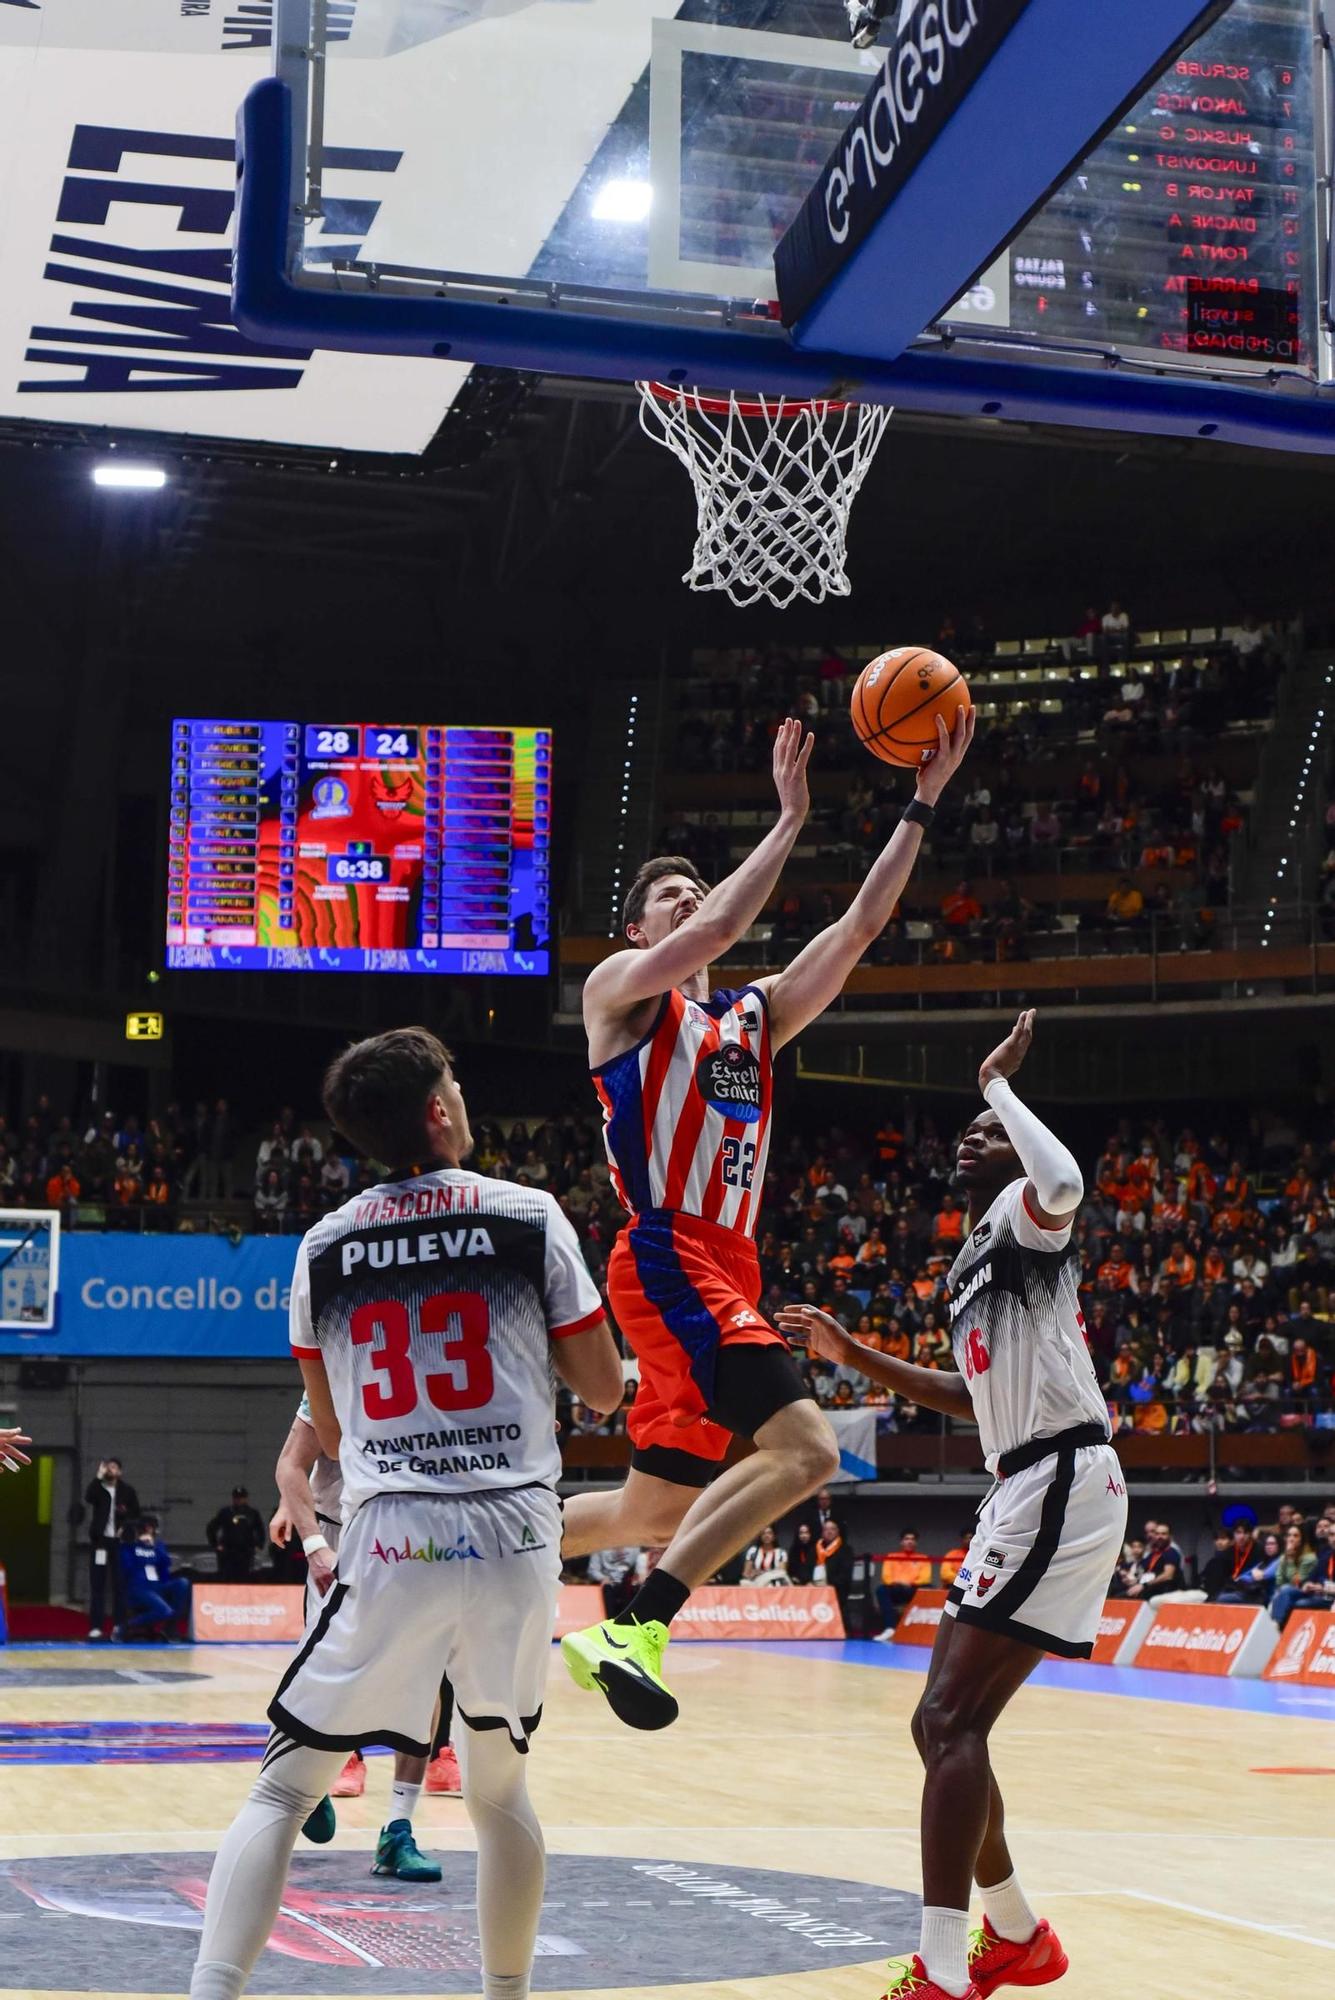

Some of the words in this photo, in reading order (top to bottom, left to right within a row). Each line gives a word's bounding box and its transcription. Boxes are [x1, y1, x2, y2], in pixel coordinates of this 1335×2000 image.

[17, 124, 404, 392] LEYMA
[317, 731, 349, 753] 28
[376, 734, 409, 755] 24
[336, 859, 383, 879] 6:38
[714, 1079, 759, 1104] Galici
[722, 1136, 756, 1191] 22
[354, 1186, 479, 1224] VISCONTI
[342, 1228, 495, 1275] PULEVA
[81, 1277, 242, 1310] Concello
[350, 1292, 494, 1420] 33
[362, 1424, 521, 1455] AYUNTAMIENTO
[379, 1459, 402, 1474] DE
[408, 1452, 511, 1475] GRANADA
[632, 1863, 758, 1897] MOTOR
